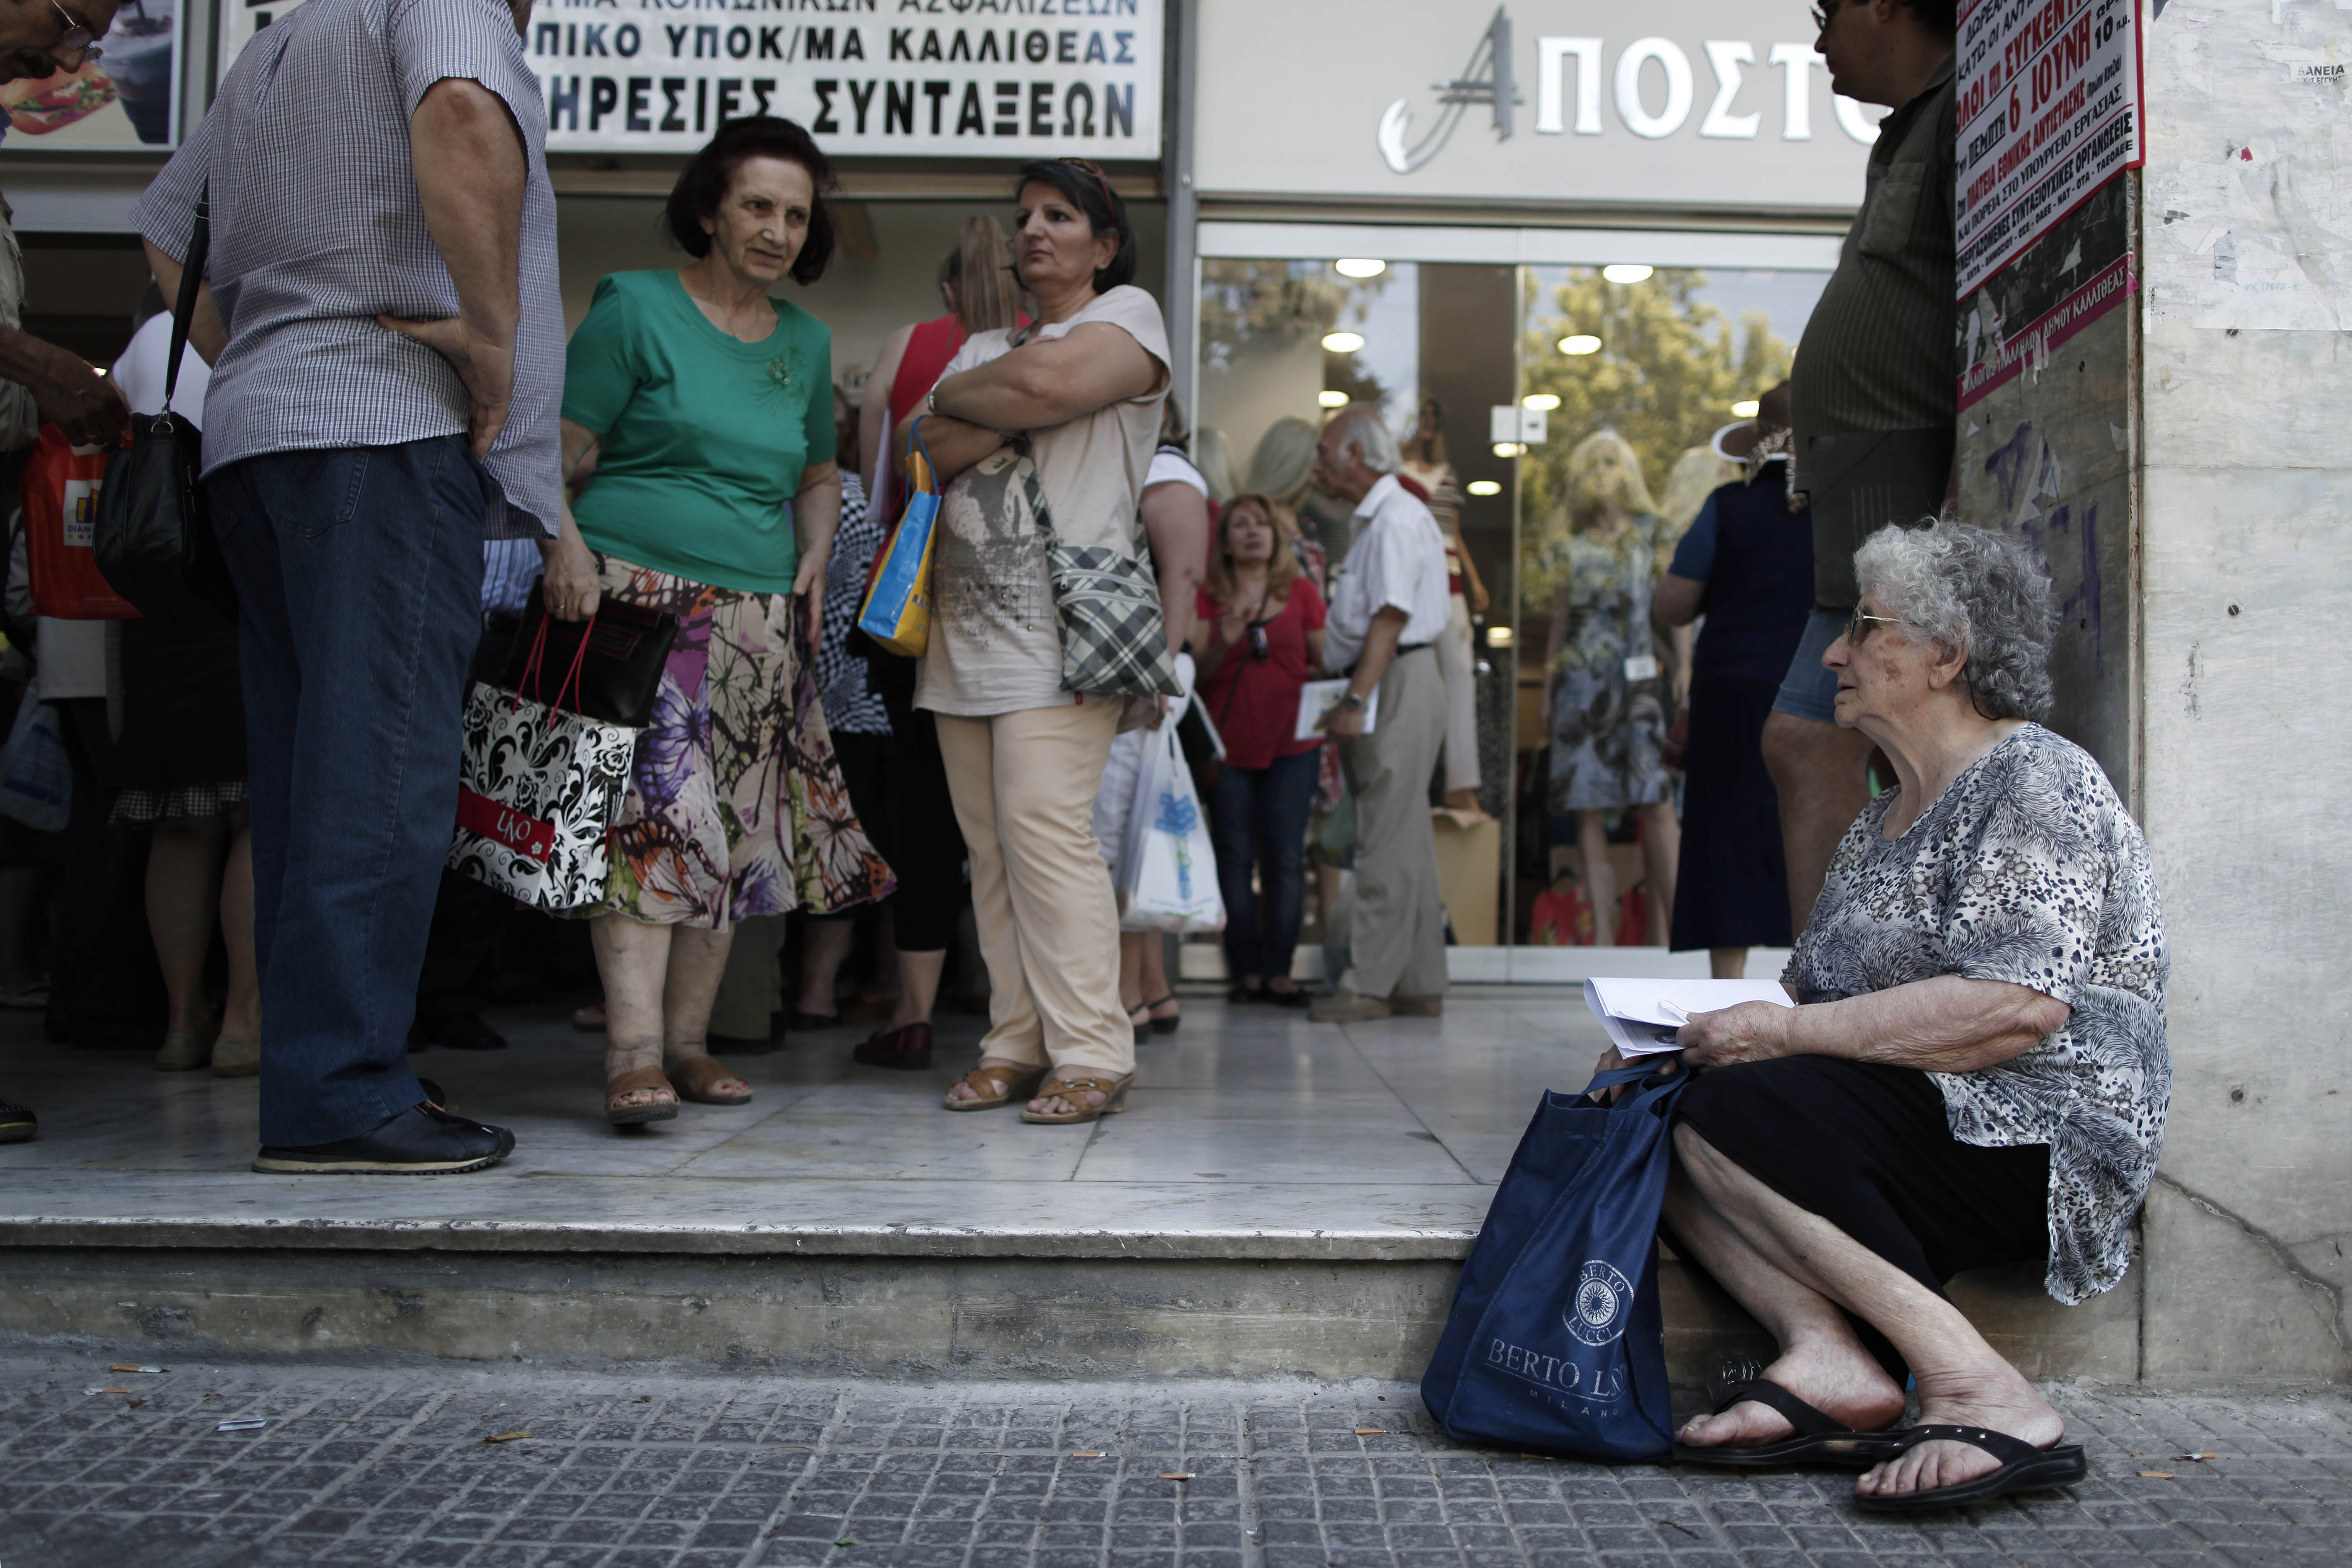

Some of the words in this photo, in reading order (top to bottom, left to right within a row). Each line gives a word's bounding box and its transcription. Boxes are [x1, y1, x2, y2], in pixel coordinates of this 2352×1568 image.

[522, 23, 640, 57] ΠΙΚΟ
[666, 25, 865, 63] ΥΠΟΚ/ΜΑ
[890, 27, 1135, 63] ΚΑΛΛΙΘΕΑΣ
[2095, 15, 2113, 50] 10
[2009, 83, 2020, 133] 6
[2031, 9, 2092, 114] ΙΟΥΝΗ
[535, 75, 776, 132] ΗΡΕΣΙΕΣ
[814, 79, 1134, 137] ΣΥΝΤΑΞΕΩΝ
[2033, 78, 2085, 151] ΑΝΤΙΣΤΑΣΗΣ
[1972, 193, 2001, 230] ΠΟΡΕΙΑ
[2002, 176, 2019, 202] ΣΤΟ
[2021, 129, 2071, 185] ΥΠΟΥΡΓΕΙΟ
[2074, 83, 2122, 139] ΕΡΓΑΣΙΑΣ
[2076, 111, 2133, 173] ΟΡΓΑΝΩΣΕΙΣ
[2058, 187, 2070, 206] ΝΑΤ
[2077, 171, 2090, 189] ΟΤΑ
[2073, 266, 2125, 319] ΚΑΛΛΙΘΕΑΣ
[1579, 1265, 1625, 1291] BERTO
[1568, 1316, 1612, 1341] LUCCI
[1488, 1338, 1580, 1388] BERTO
[1530, 1389, 1618, 1416] MILANO
